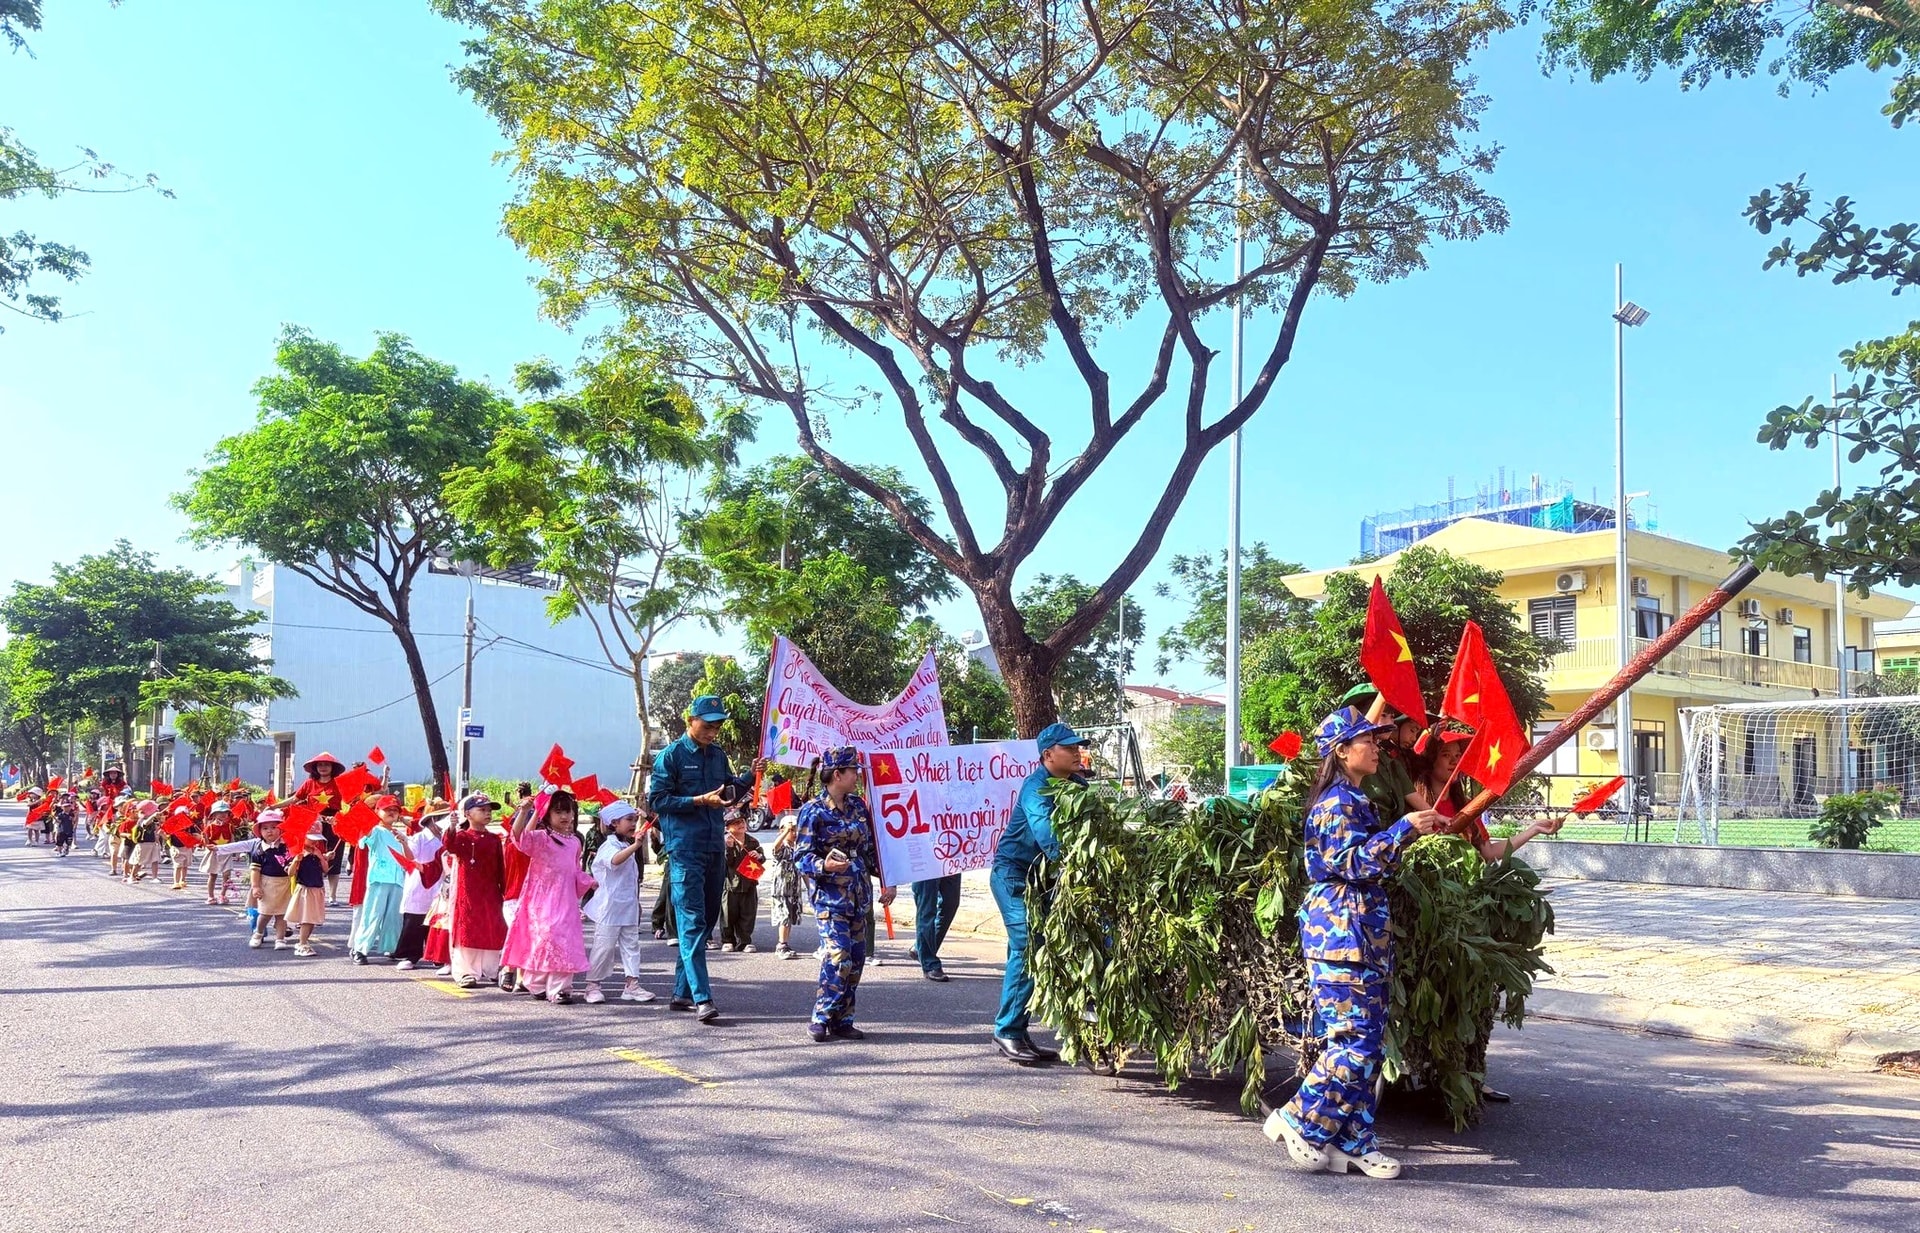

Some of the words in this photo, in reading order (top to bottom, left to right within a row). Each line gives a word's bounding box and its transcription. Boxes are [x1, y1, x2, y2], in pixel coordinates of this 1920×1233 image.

[904, 752, 953, 786] Nhiệt
[956, 755, 984, 786] liệt
[989, 752, 1027, 781] Chào
[880, 789, 931, 840] 51
[931, 803, 969, 832] năm
[966, 798, 996, 839] giải
[933, 829, 979, 860] Đà
